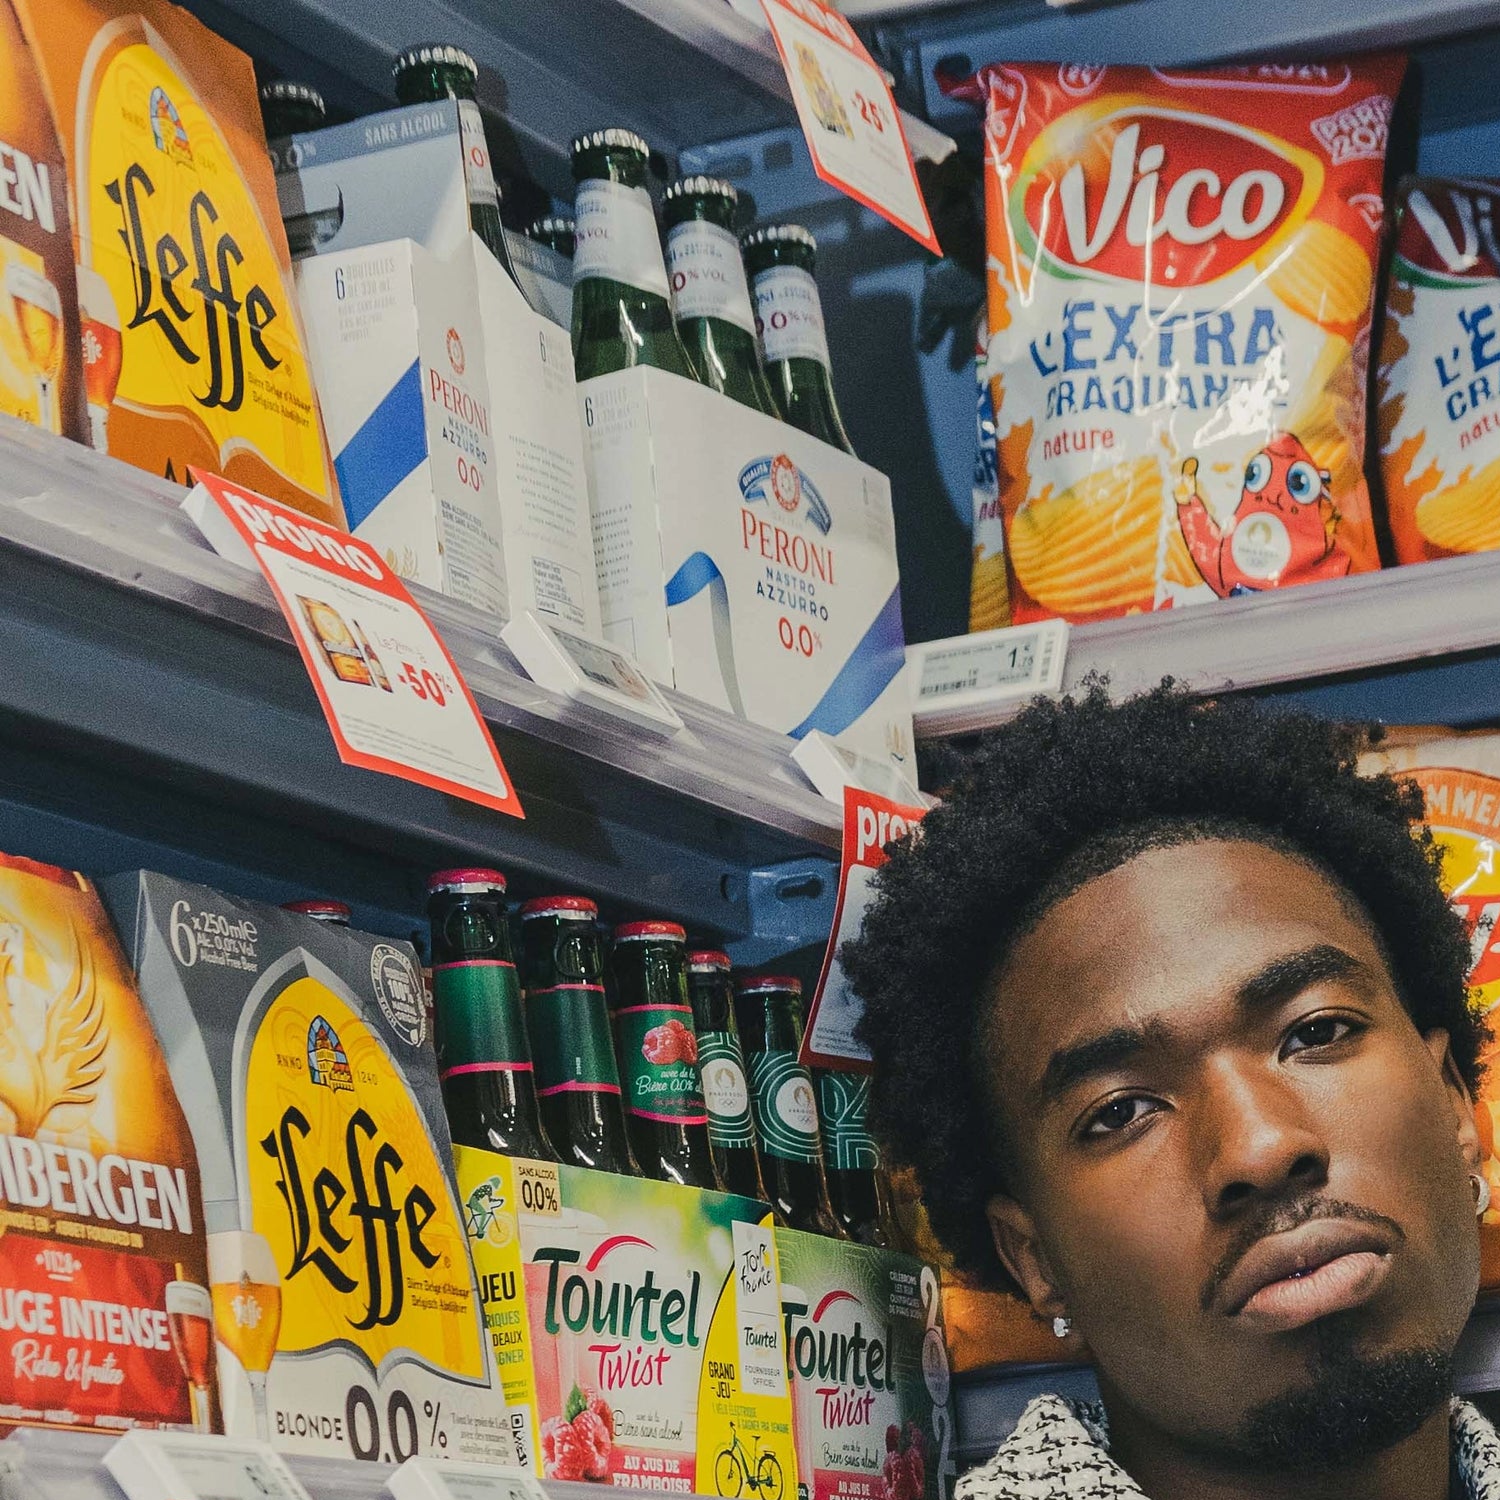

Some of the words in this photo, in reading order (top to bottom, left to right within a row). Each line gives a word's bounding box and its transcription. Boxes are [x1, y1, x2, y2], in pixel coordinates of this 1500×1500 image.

[365, 120, 398, 147] SANS
[401, 110, 447, 141] ALCOOL
[1060, 123, 1286, 264] Vico
[104, 163, 283, 413] Leffe
[335, 267, 346, 300] 6
[702, 267, 727, 282] VOL
[1029, 300, 1286, 377] L'EXTRA
[430, 367, 489, 437] PERONI
[442, 426, 488, 465] AZZURRO
[448, 415, 480, 444] NASTRO
[1043, 427, 1115, 461] nature
[222, 490, 384, 582] promo
[741, 508, 835, 585] PERONI
[766, 566, 816, 597] NASTRO
[756, 581, 830, 622] AZZURRO
[778, 616, 823, 658] 0.0%
[170, 899, 198, 968] 6
[276, 1052, 303, 1071] ANNO
[357, 1069, 379, 1086] 1240
[518, 1166, 534, 1178] SANS
[534, 1169, 557, 1181] ALCOOL
[521, 1178, 559, 1213] 0,0%
[260, 1105, 442, 1331] Leffe
[480, 1270, 517, 1304] JEU
[532, 1246, 701, 1348] Tourtel
[59, 1295, 171, 1351] INTENSE
[492, 1330, 523, 1348] DEAUX
[743, 1326, 778, 1350] Tourtel
[782, 1300, 898, 1393] Tourtel
[588, 1343, 671, 1392] Twist
[708, 1360, 735, 1381] GRAND
[744, 1364, 782, 1377] FOURNISSEUR
[751, 1376, 777, 1389] OFFICIEL
[276, 1409, 344, 1441] BLONDE
[815, 1385, 876, 1431] Twist
[623, 1455, 639, 1470] AU
[642, 1458, 663, 1473] JUS
[665, 1460, 680, 1474] DE
[613, 1471, 692, 1495] FRAMBOISE
